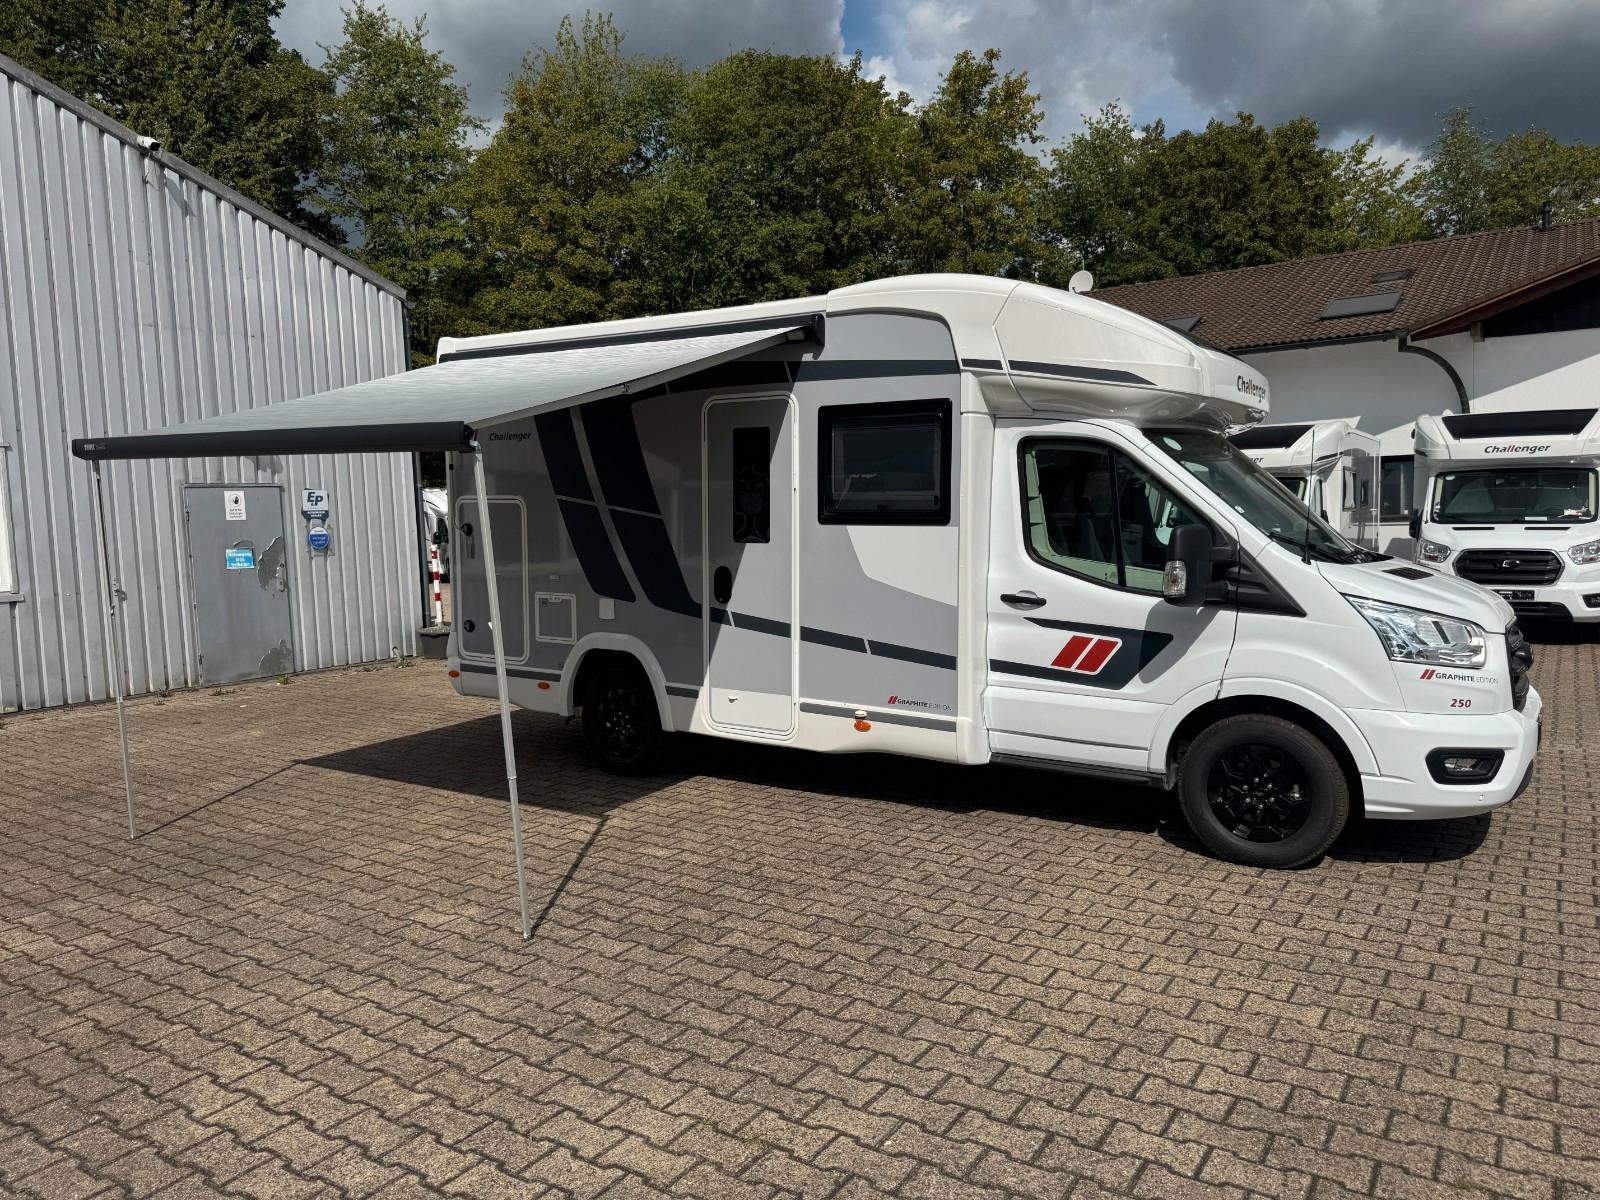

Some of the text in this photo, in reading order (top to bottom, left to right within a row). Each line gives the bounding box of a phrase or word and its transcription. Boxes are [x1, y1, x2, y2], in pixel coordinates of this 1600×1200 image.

[489, 431, 532, 442] Challenger
[1484, 444, 1551, 454] Challenger
[1435, 672, 1476, 683] GRAPHITE
[897, 698, 929, 708] GRAPHITE
[1450, 698, 1472, 708] 250
